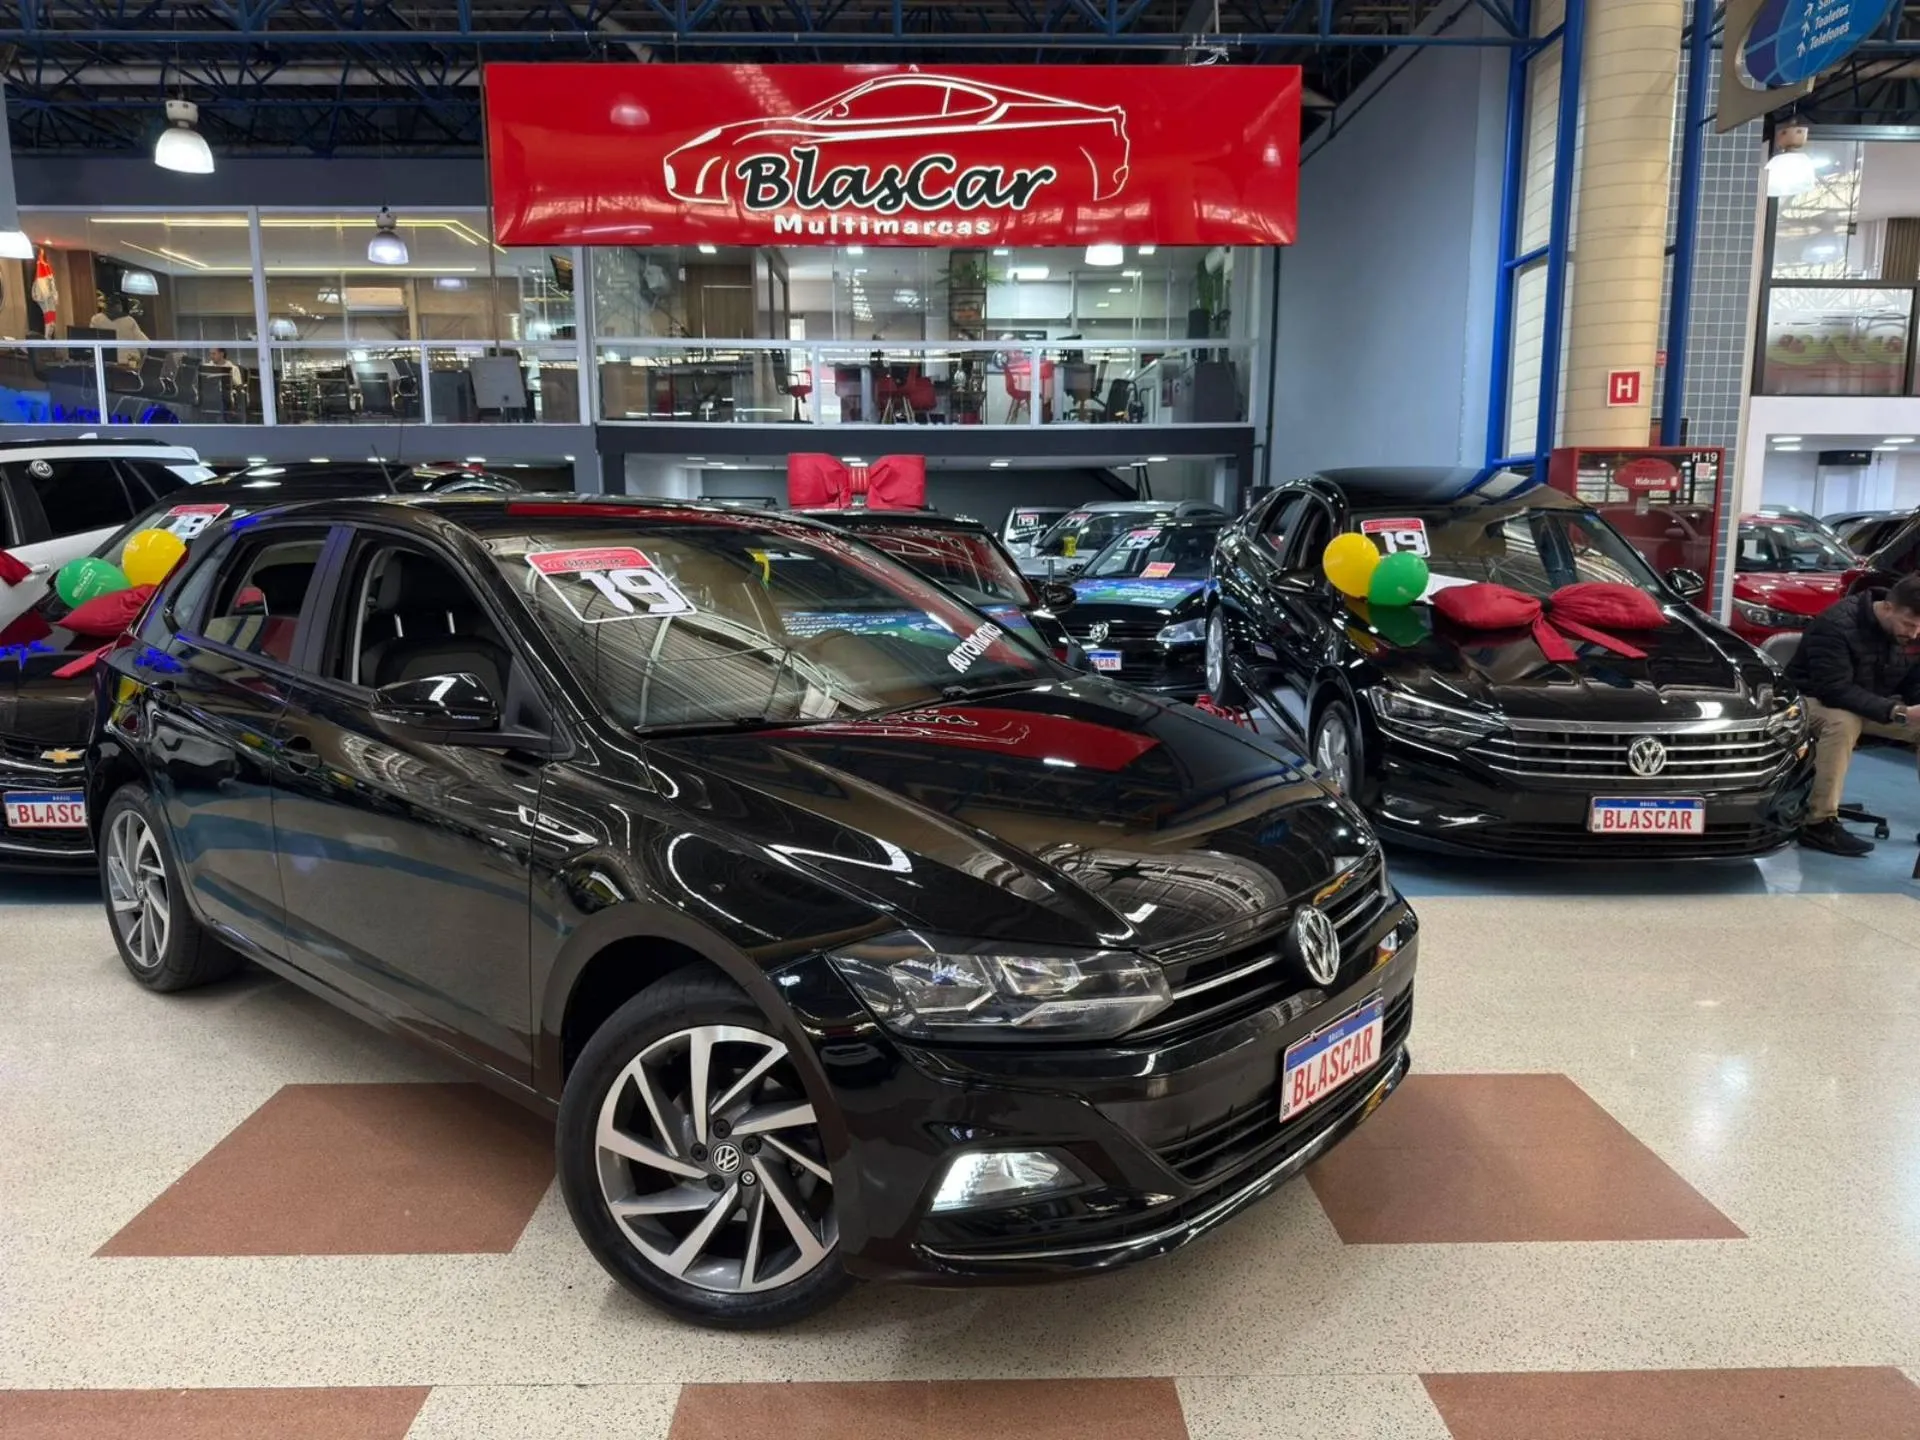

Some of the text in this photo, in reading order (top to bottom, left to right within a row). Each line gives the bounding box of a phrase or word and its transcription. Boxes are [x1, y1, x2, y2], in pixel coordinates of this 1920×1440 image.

[736, 145, 1056, 214] BlasCar
[774, 213, 991, 236] Multimarcas
[1616, 377, 1632, 398] H
[1692, 452, 1718, 462] H 19
[1635, 477, 1666, 486] Hidrante
[1380, 531, 1426, 555] 19
[579, 568, 688, 613] 19
[17, 804, 83, 823] BLASC
[1602, 810, 1692, 829] BLASCAR
[1292, 1026, 1374, 1107] BLASCAR
